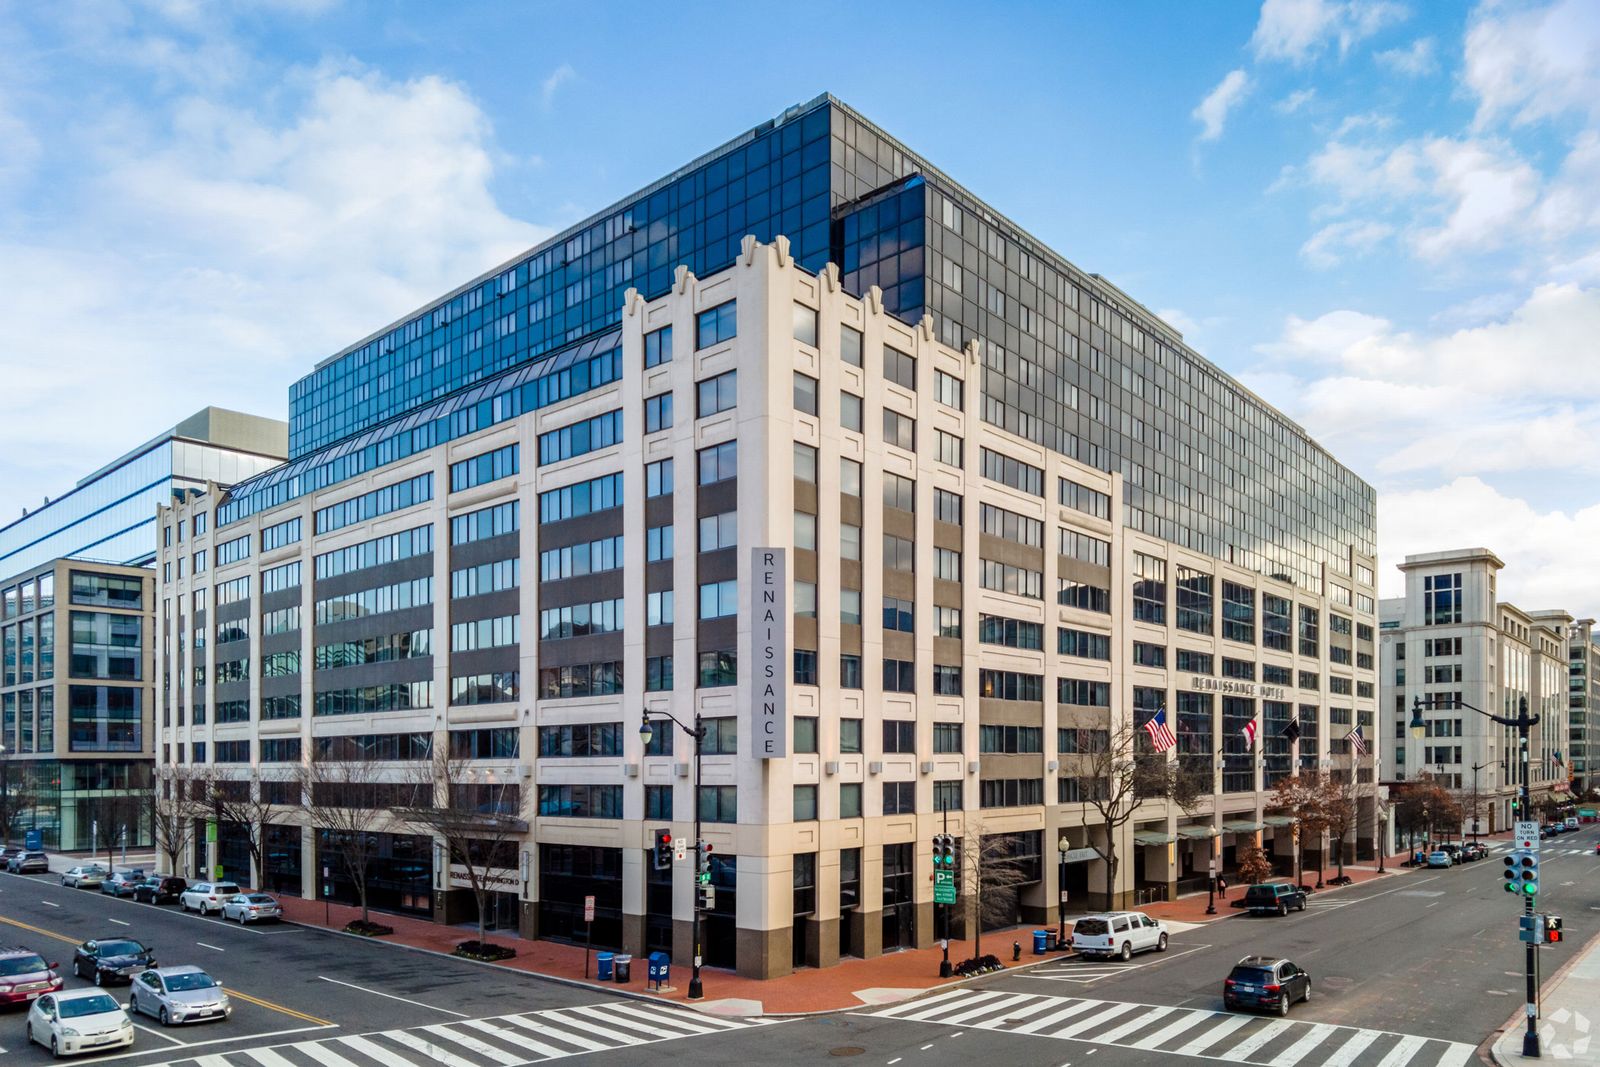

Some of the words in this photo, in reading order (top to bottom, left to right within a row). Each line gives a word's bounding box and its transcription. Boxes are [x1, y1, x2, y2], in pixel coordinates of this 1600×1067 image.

[763, 553, 775, 753] RENAISSANCE
[1192, 677, 1255, 696] RENAISSANCE
[1260, 686, 1284, 700] HOTEL
[450, 872, 484, 882] RENAISSCE
